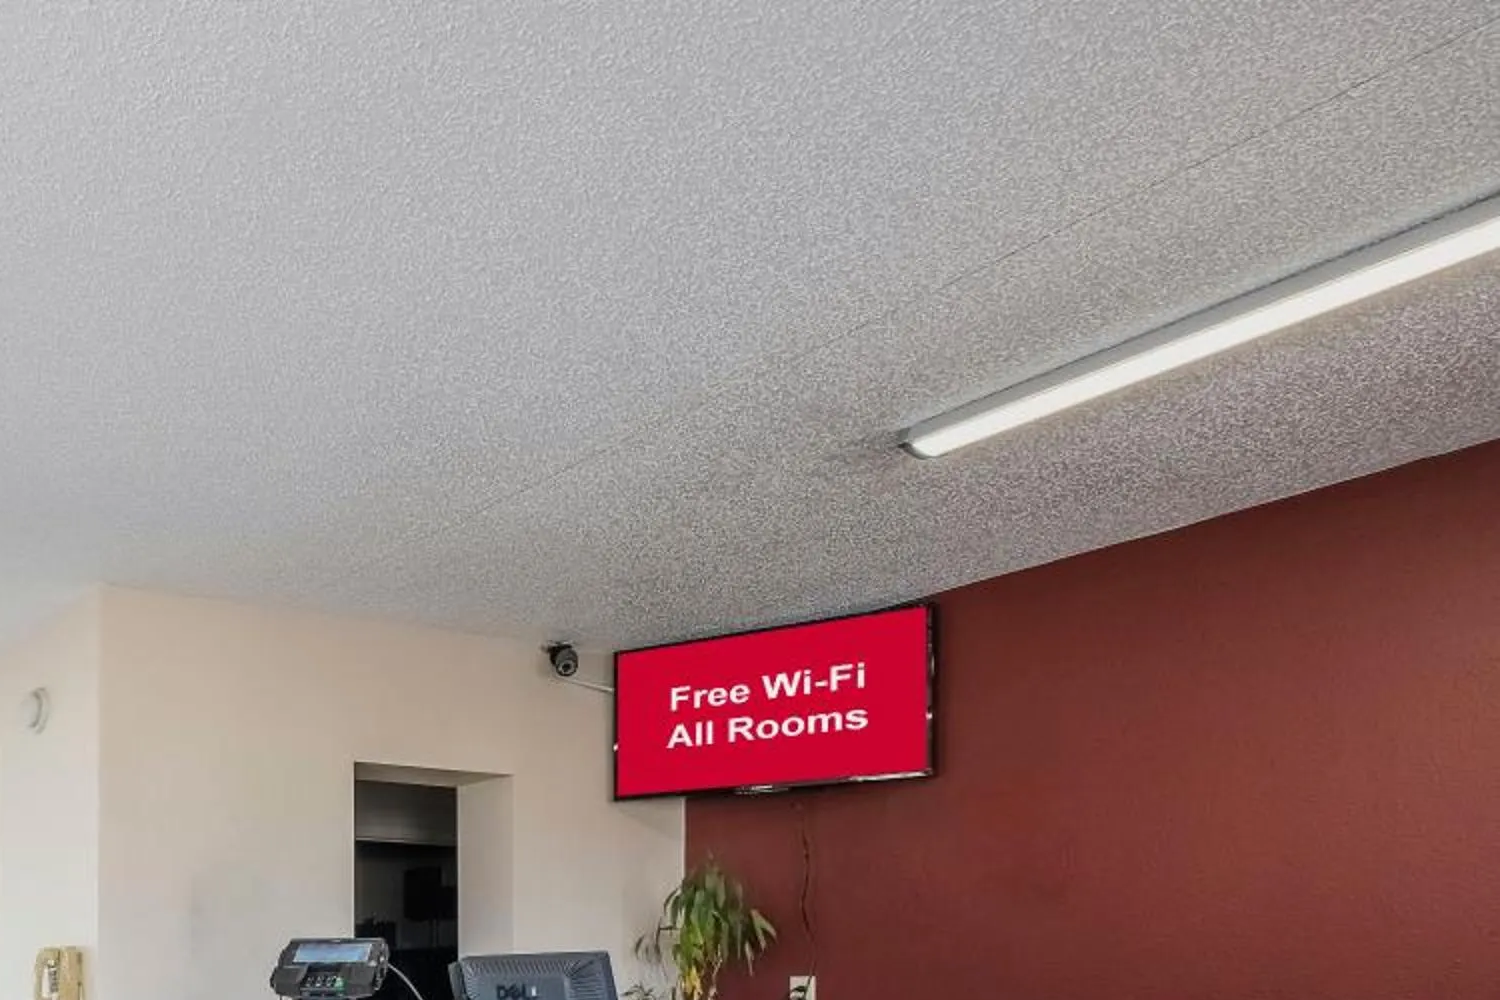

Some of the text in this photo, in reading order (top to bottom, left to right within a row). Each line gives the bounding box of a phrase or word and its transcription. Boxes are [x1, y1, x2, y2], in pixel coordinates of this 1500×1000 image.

[670, 662, 866, 712] Free Wi-Fi
[666, 708, 869, 749] All Rooms
